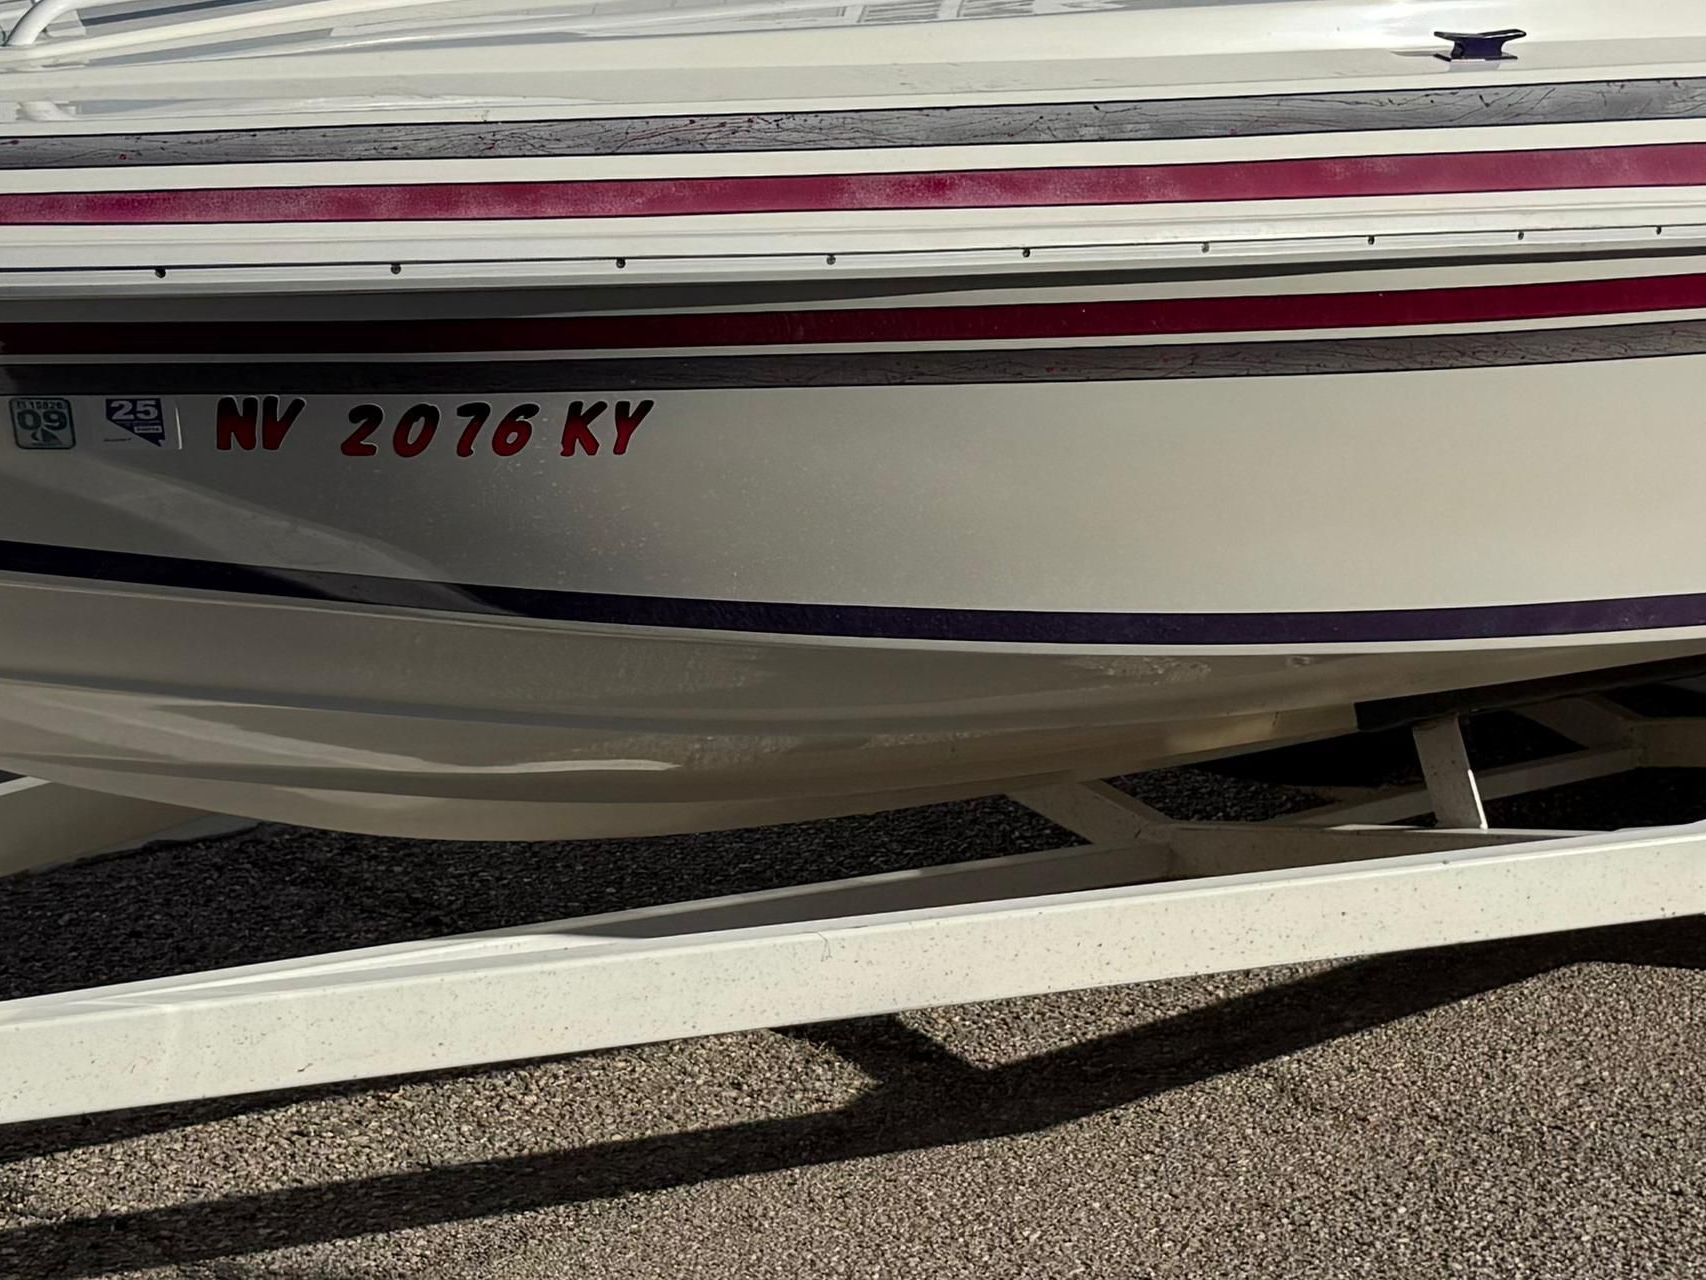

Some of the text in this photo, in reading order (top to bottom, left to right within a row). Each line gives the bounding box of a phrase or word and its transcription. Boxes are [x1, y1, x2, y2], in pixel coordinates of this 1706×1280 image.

[17, 410, 68, 431] 09
[110, 400, 159, 420] 25
[216, 394, 655, 458] NV 2076 KY
